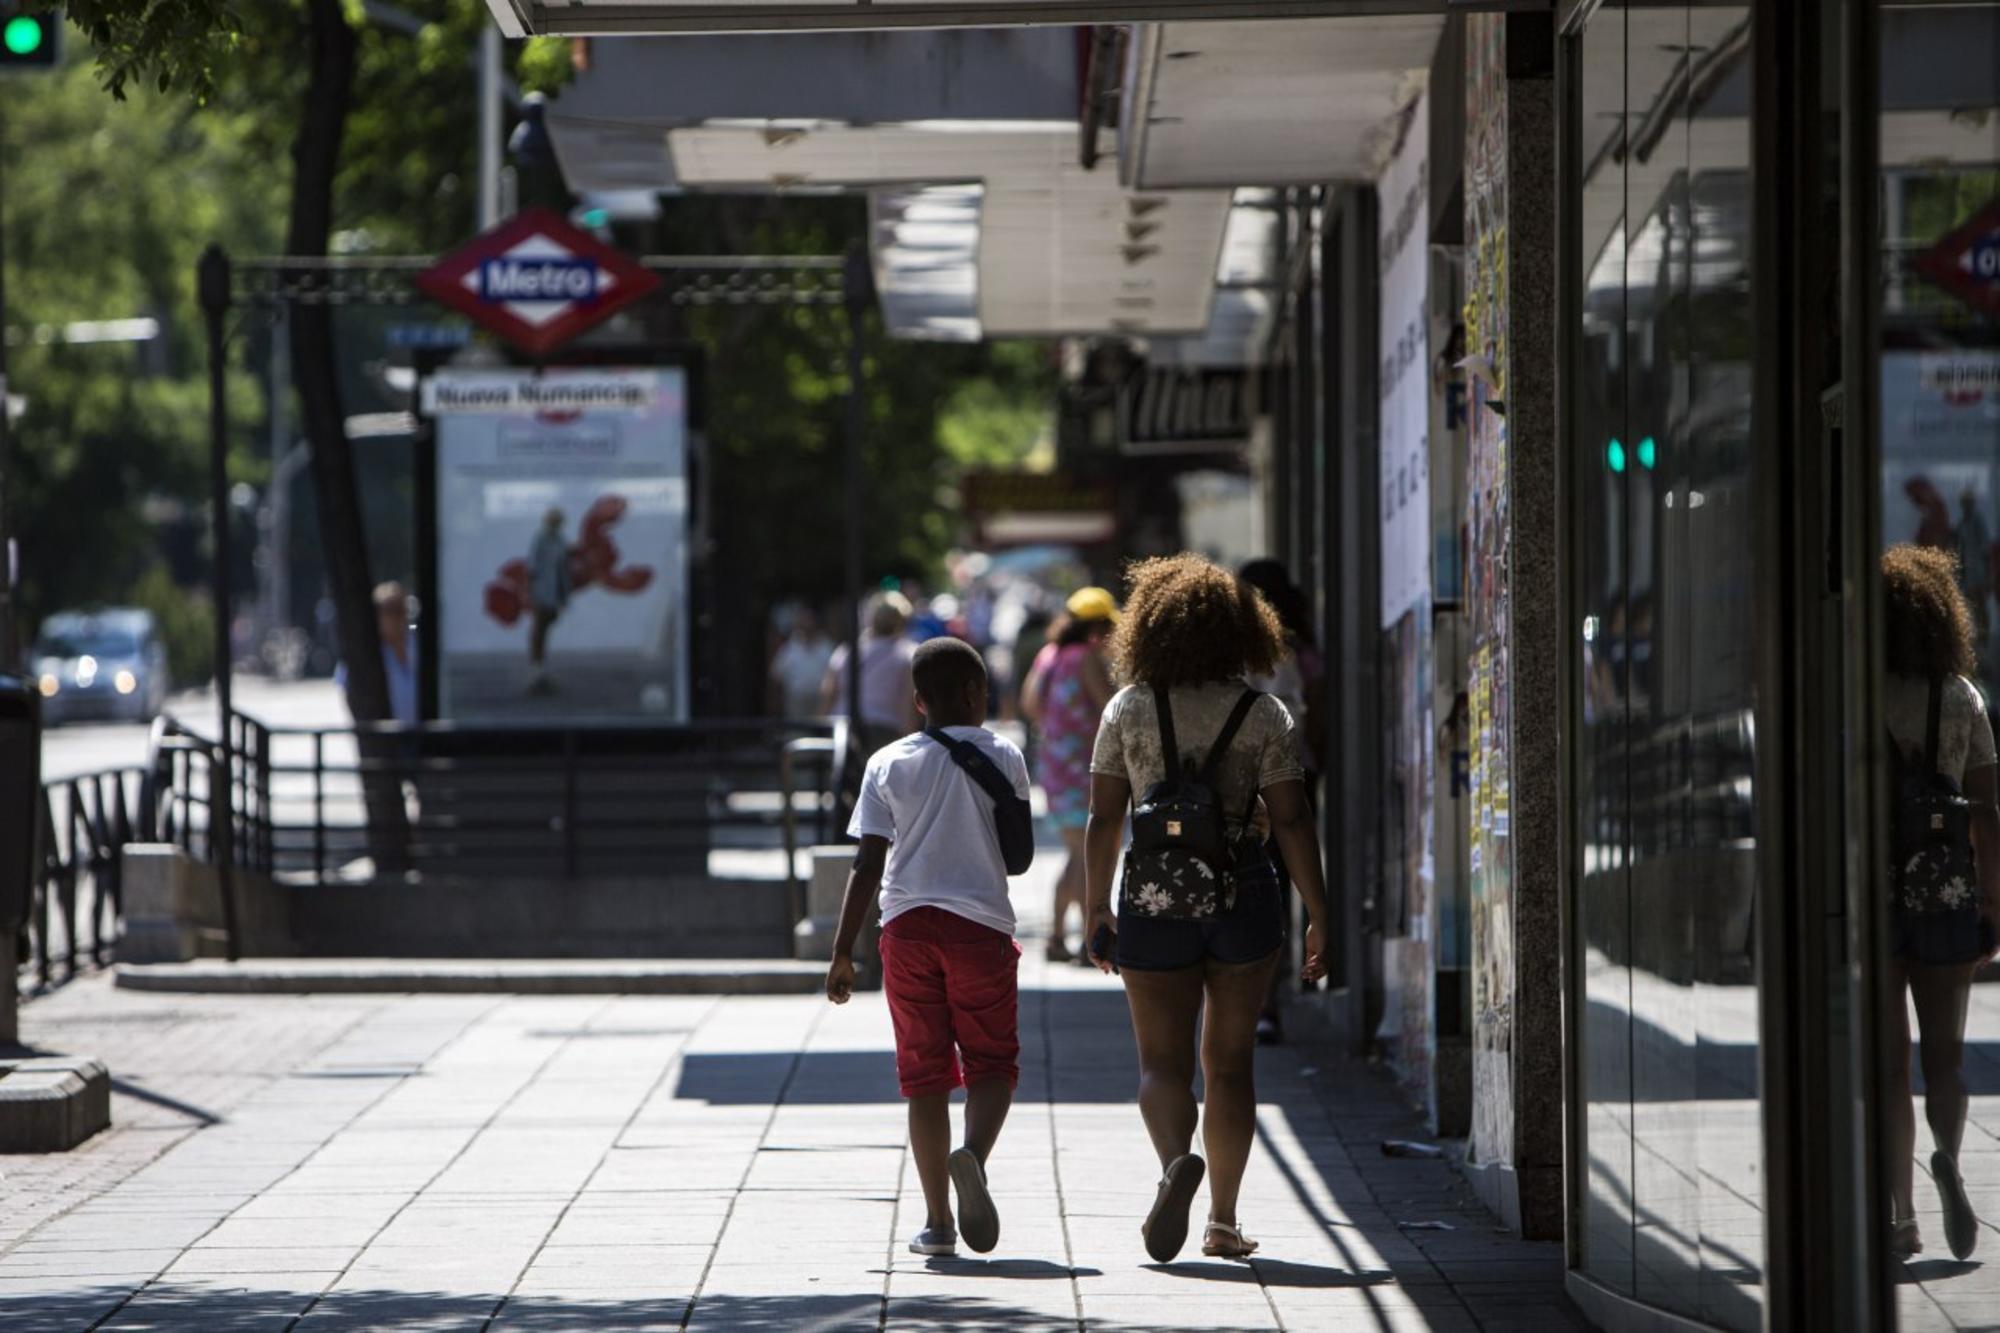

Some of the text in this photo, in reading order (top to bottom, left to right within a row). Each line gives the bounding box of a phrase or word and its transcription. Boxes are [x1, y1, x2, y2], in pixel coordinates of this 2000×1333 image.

[486, 261, 591, 296] Metro
[436, 375, 642, 405] Nueva Numancia
